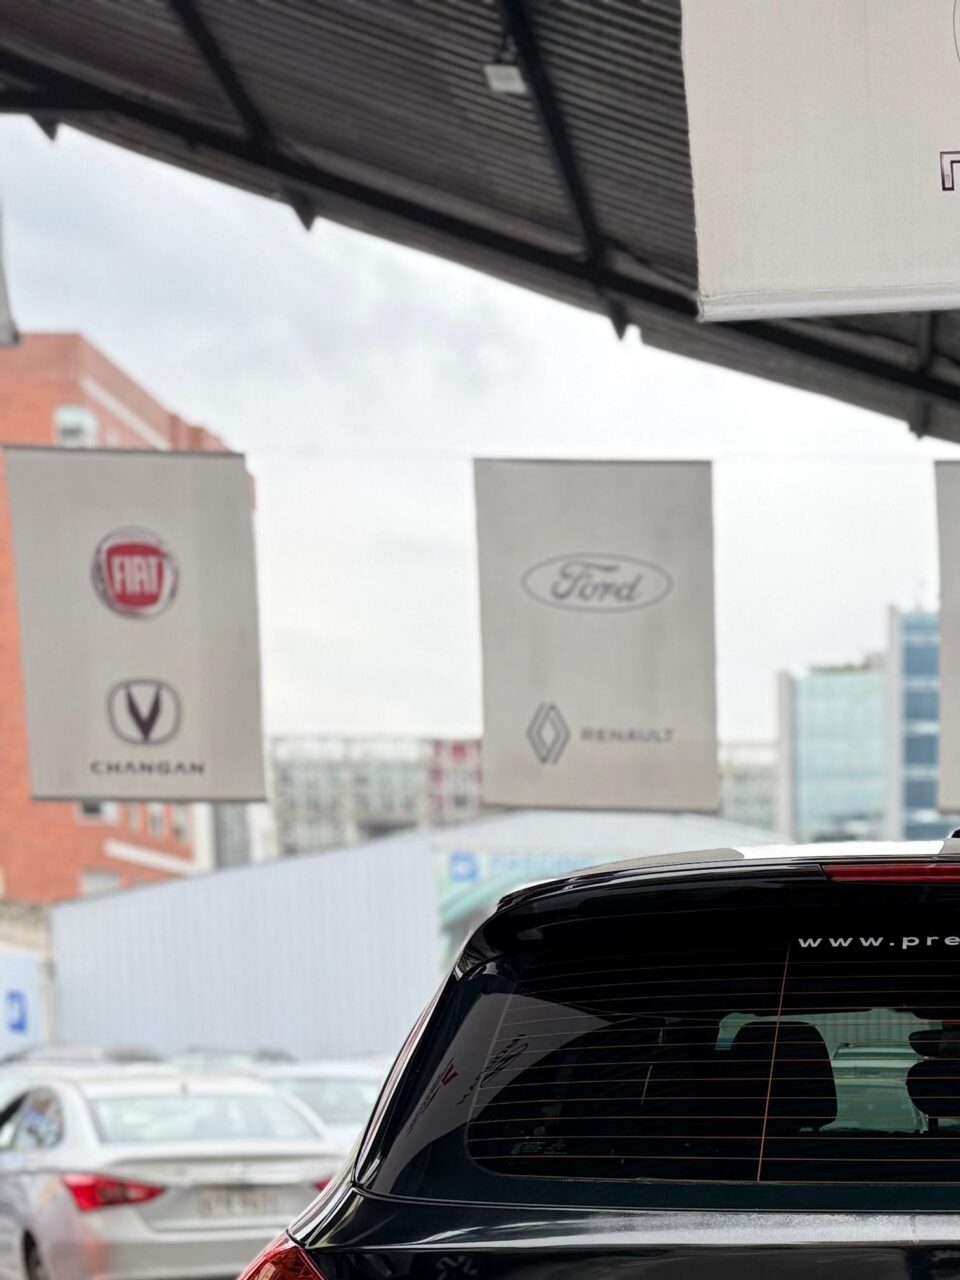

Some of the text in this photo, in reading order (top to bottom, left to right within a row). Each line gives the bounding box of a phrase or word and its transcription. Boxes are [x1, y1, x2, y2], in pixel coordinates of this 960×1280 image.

[111, 554, 160, 596] FIAT
[551, 560, 644, 602] Ford
[580, 727, 674, 744] RENAULT
[90, 760, 206, 776] CHANGAN
